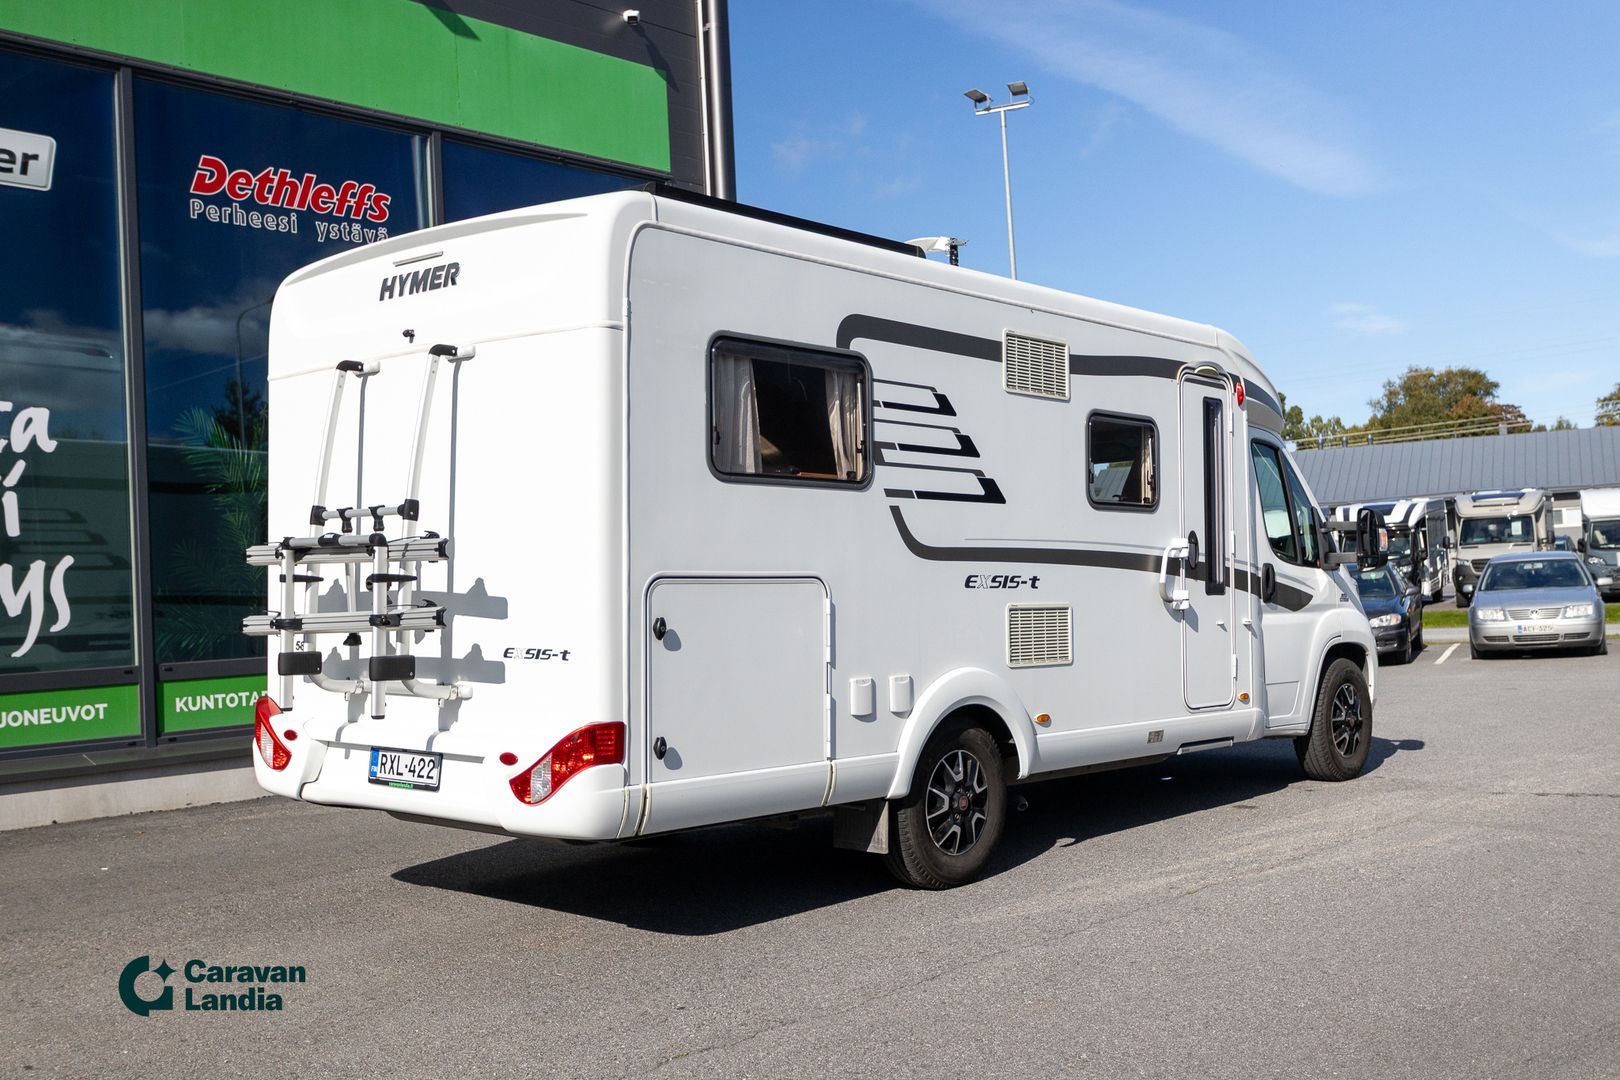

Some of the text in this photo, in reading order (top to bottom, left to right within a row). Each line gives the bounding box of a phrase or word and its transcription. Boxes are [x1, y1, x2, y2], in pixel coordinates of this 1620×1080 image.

[190, 154, 392, 223] Dethleffs
[190, 198, 298, 234] Perheesi
[379, 261, 461, 302] HYMER
[964, 574, 1041, 590] EXSIS-t
[503, 646, 571, 662] EXSIS-t
[175, 690, 267, 713] KUNTOTA
[380, 753, 436, 780] RXL-422
